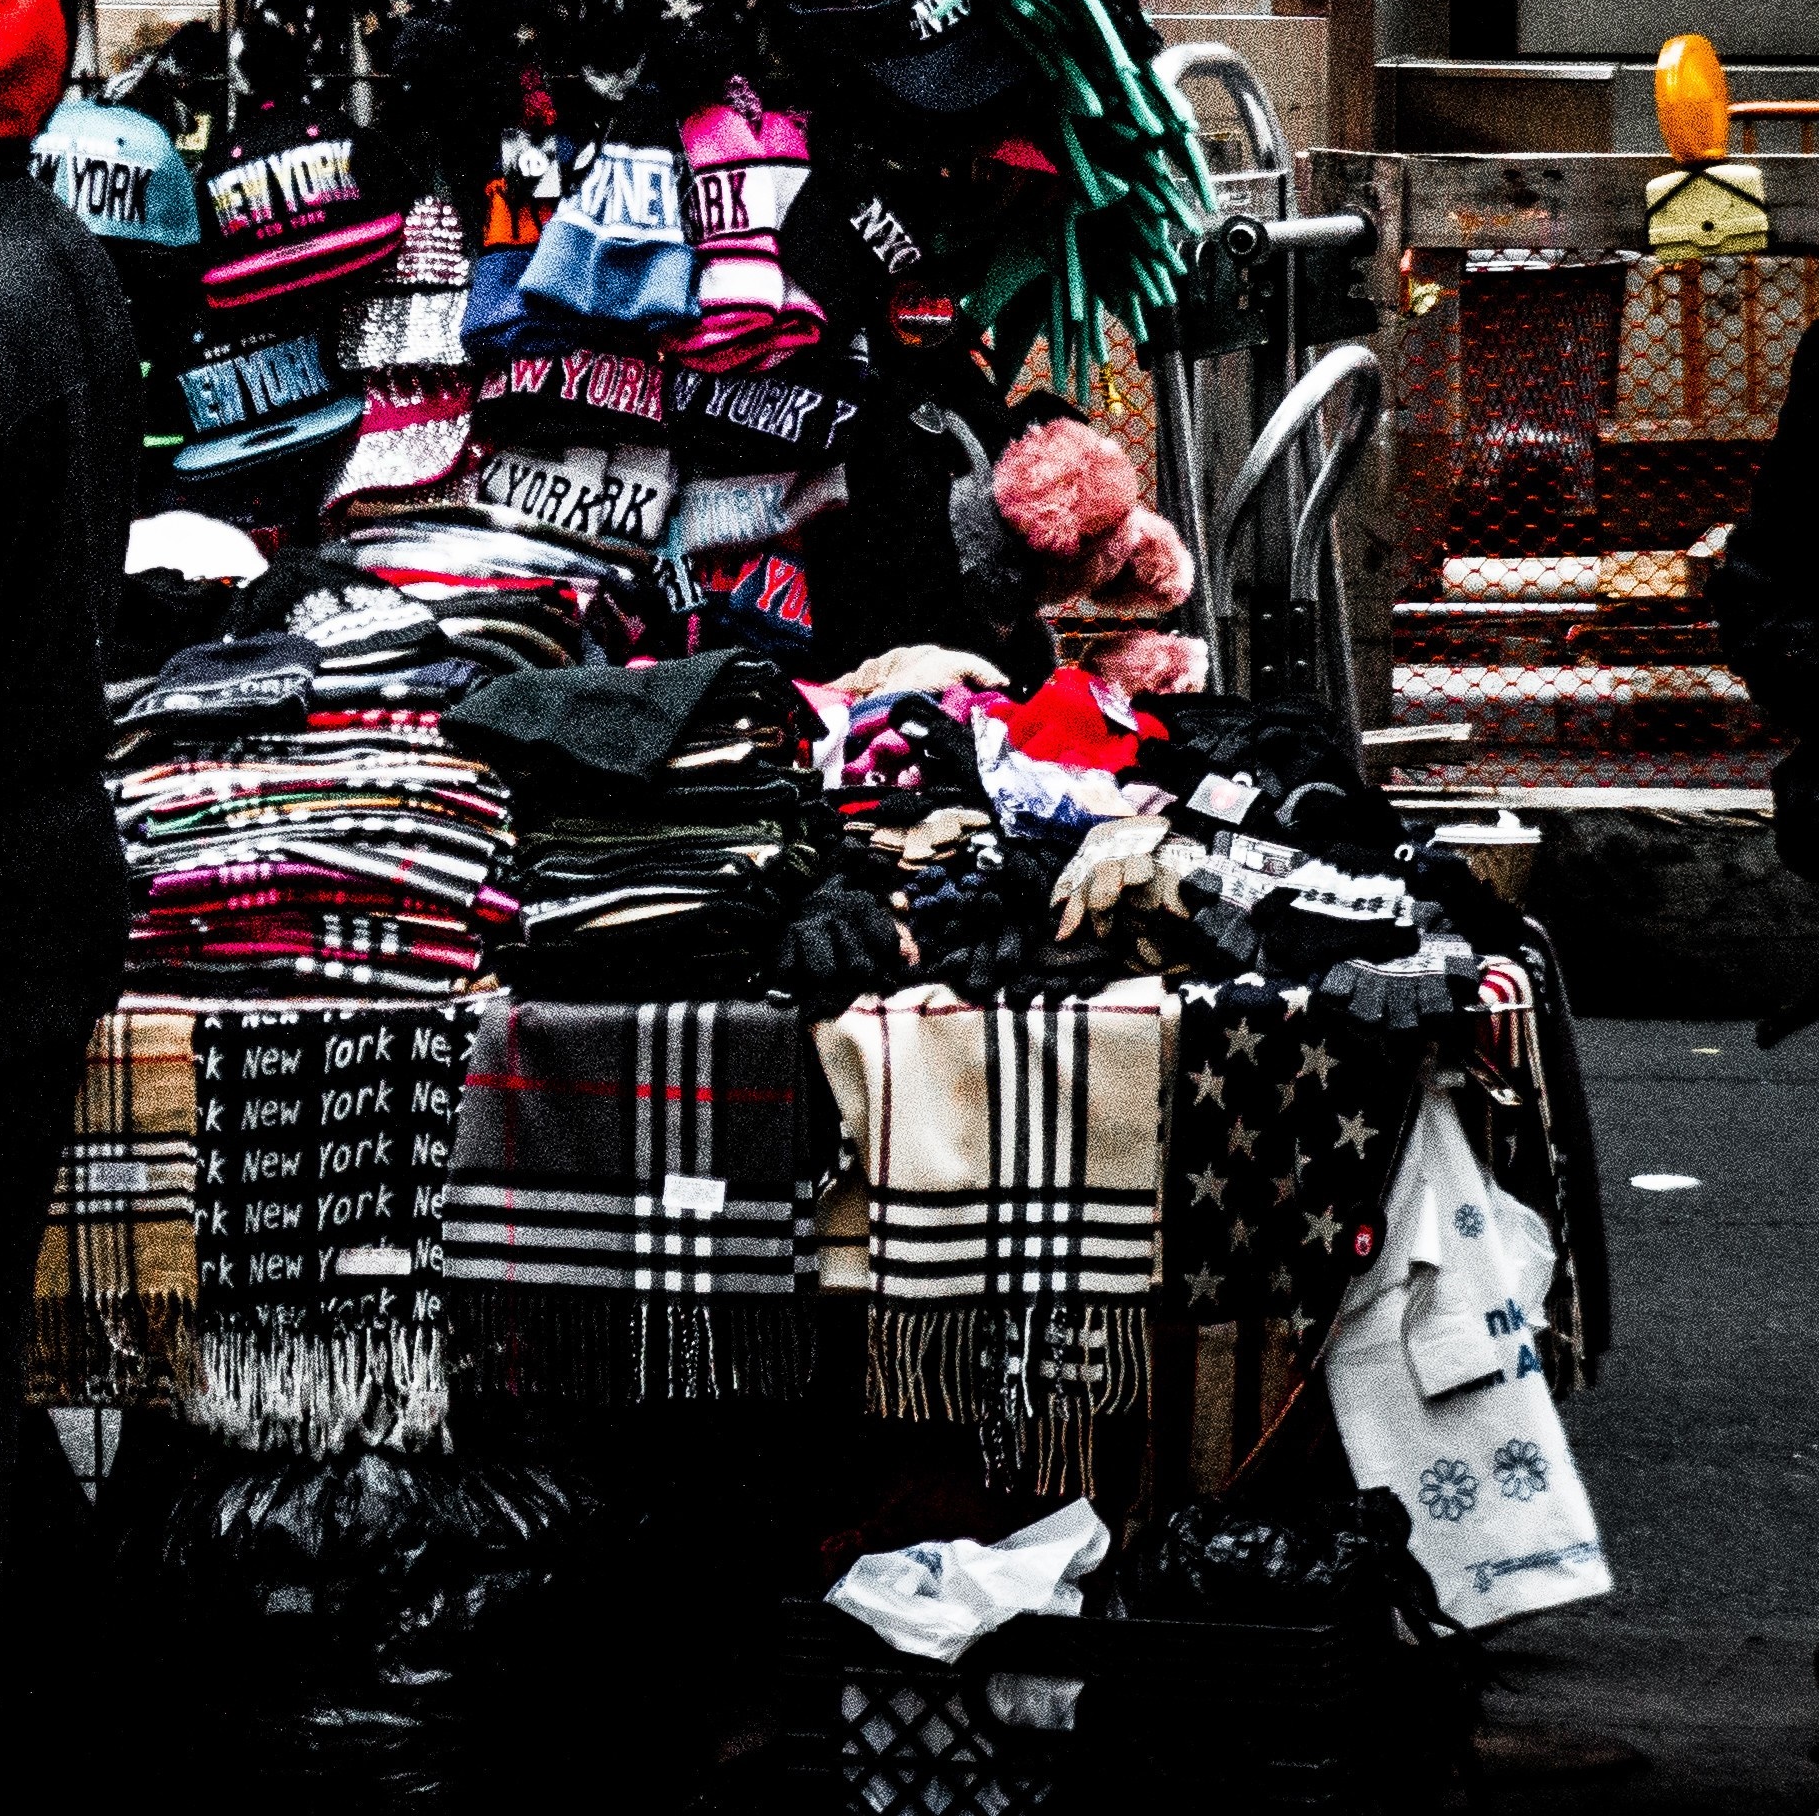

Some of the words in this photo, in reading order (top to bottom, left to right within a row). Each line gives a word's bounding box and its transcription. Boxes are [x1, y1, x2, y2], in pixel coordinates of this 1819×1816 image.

[70, 157, 152, 224] YORK
[208, 160, 274, 237] NEW
[267, 141, 361, 214] YORK
[849, 192, 924, 275] NYC
[237, 334, 329, 416] YORK
[559, 349, 665, 424] YORK
[240, 1046, 301, 1080] New
[321, 1028, 396, 1075] York
[410, 1030, 450, 1064] Ne
[240, 1095, 301, 1131] New
[318, 1080, 392, 1127] York
[410, 1080, 450, 1114] Ne
[240, 1146, 301, 1183] New
[316, 1134, 393, 1180] York
[410, 1136, 449, 1169] Ne
[243, 1198, 301, 1234] New
[316, 1184, 393, 1232] York
[411, 1186, 444, 1219] Ne
[247, 1247, 303, 1282] New
[411, 1238, 444, 1273] Ne
